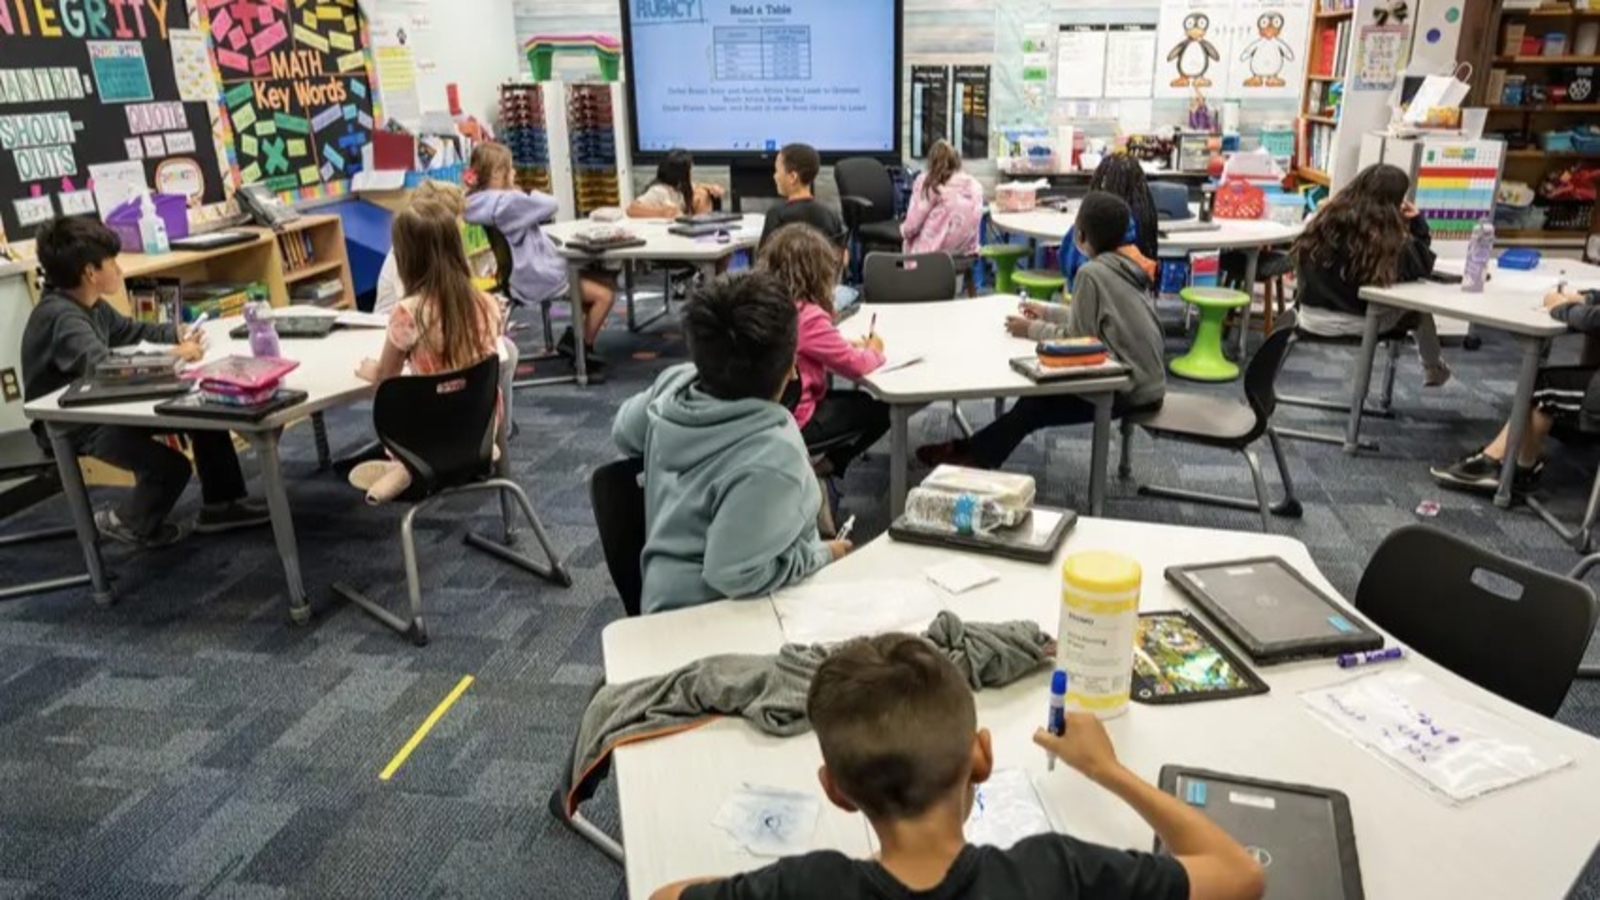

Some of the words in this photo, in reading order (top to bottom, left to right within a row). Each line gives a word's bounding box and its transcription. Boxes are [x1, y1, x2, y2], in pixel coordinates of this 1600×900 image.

[730, 4, 753, 15] Read
[765, 4, 792, 15] Table
[270, 49, 323, 79] MATH
[253, 81, 290, 113] Key
[293, 76, 347, 107] Words
[16, 146, 75, 178] OUTS
